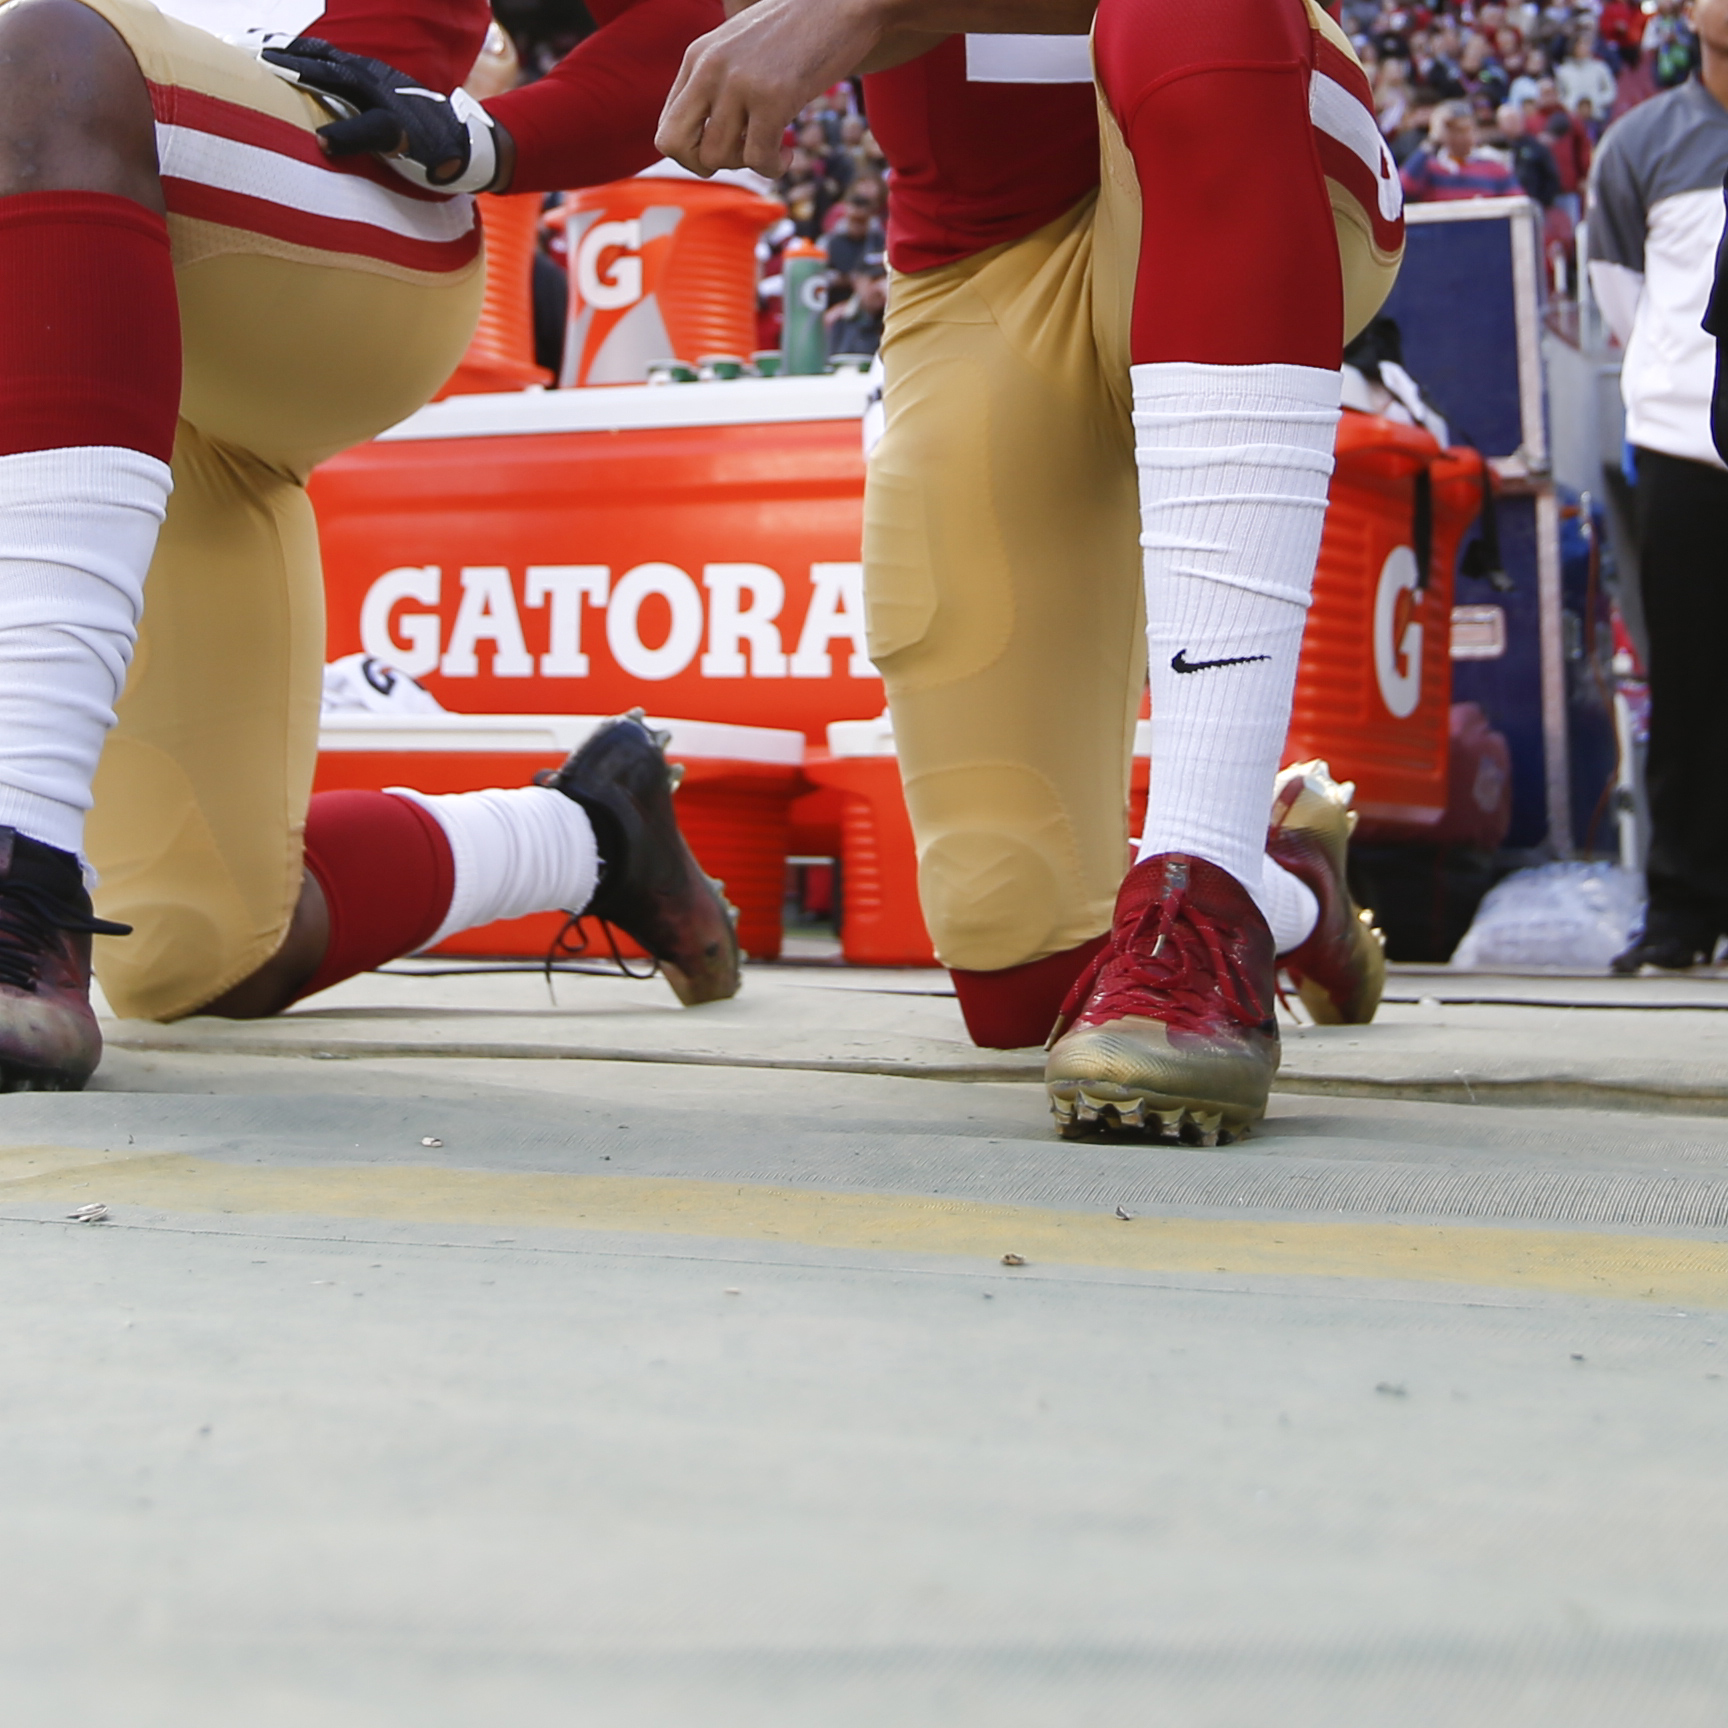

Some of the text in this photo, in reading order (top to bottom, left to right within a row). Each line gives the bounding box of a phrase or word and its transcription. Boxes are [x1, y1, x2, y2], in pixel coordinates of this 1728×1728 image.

[575, 218, 643, 311] G
[801, 275, 829, 313] G
[1374, 544, 1423, 720] G
